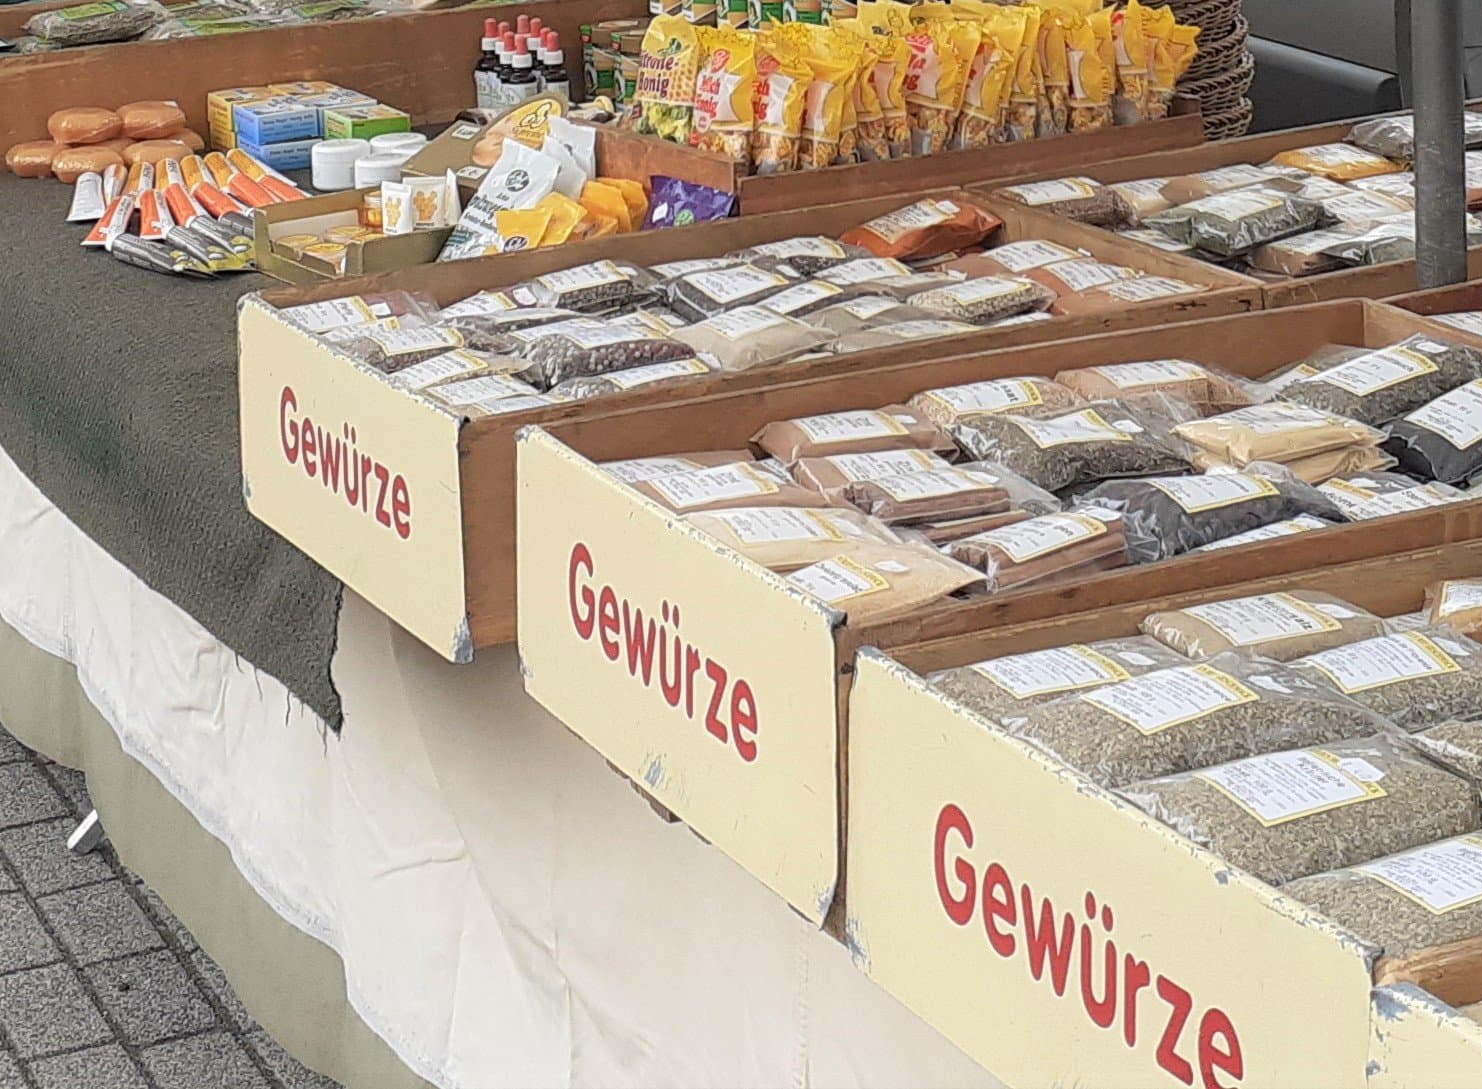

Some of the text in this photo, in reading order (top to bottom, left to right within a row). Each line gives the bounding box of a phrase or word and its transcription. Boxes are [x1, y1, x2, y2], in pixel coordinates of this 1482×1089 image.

[280, 386, 410, 539] Gewürze
[569, 542, 758, 762] Gewürze
[934, 803, 1244, 1089] Gewürze
